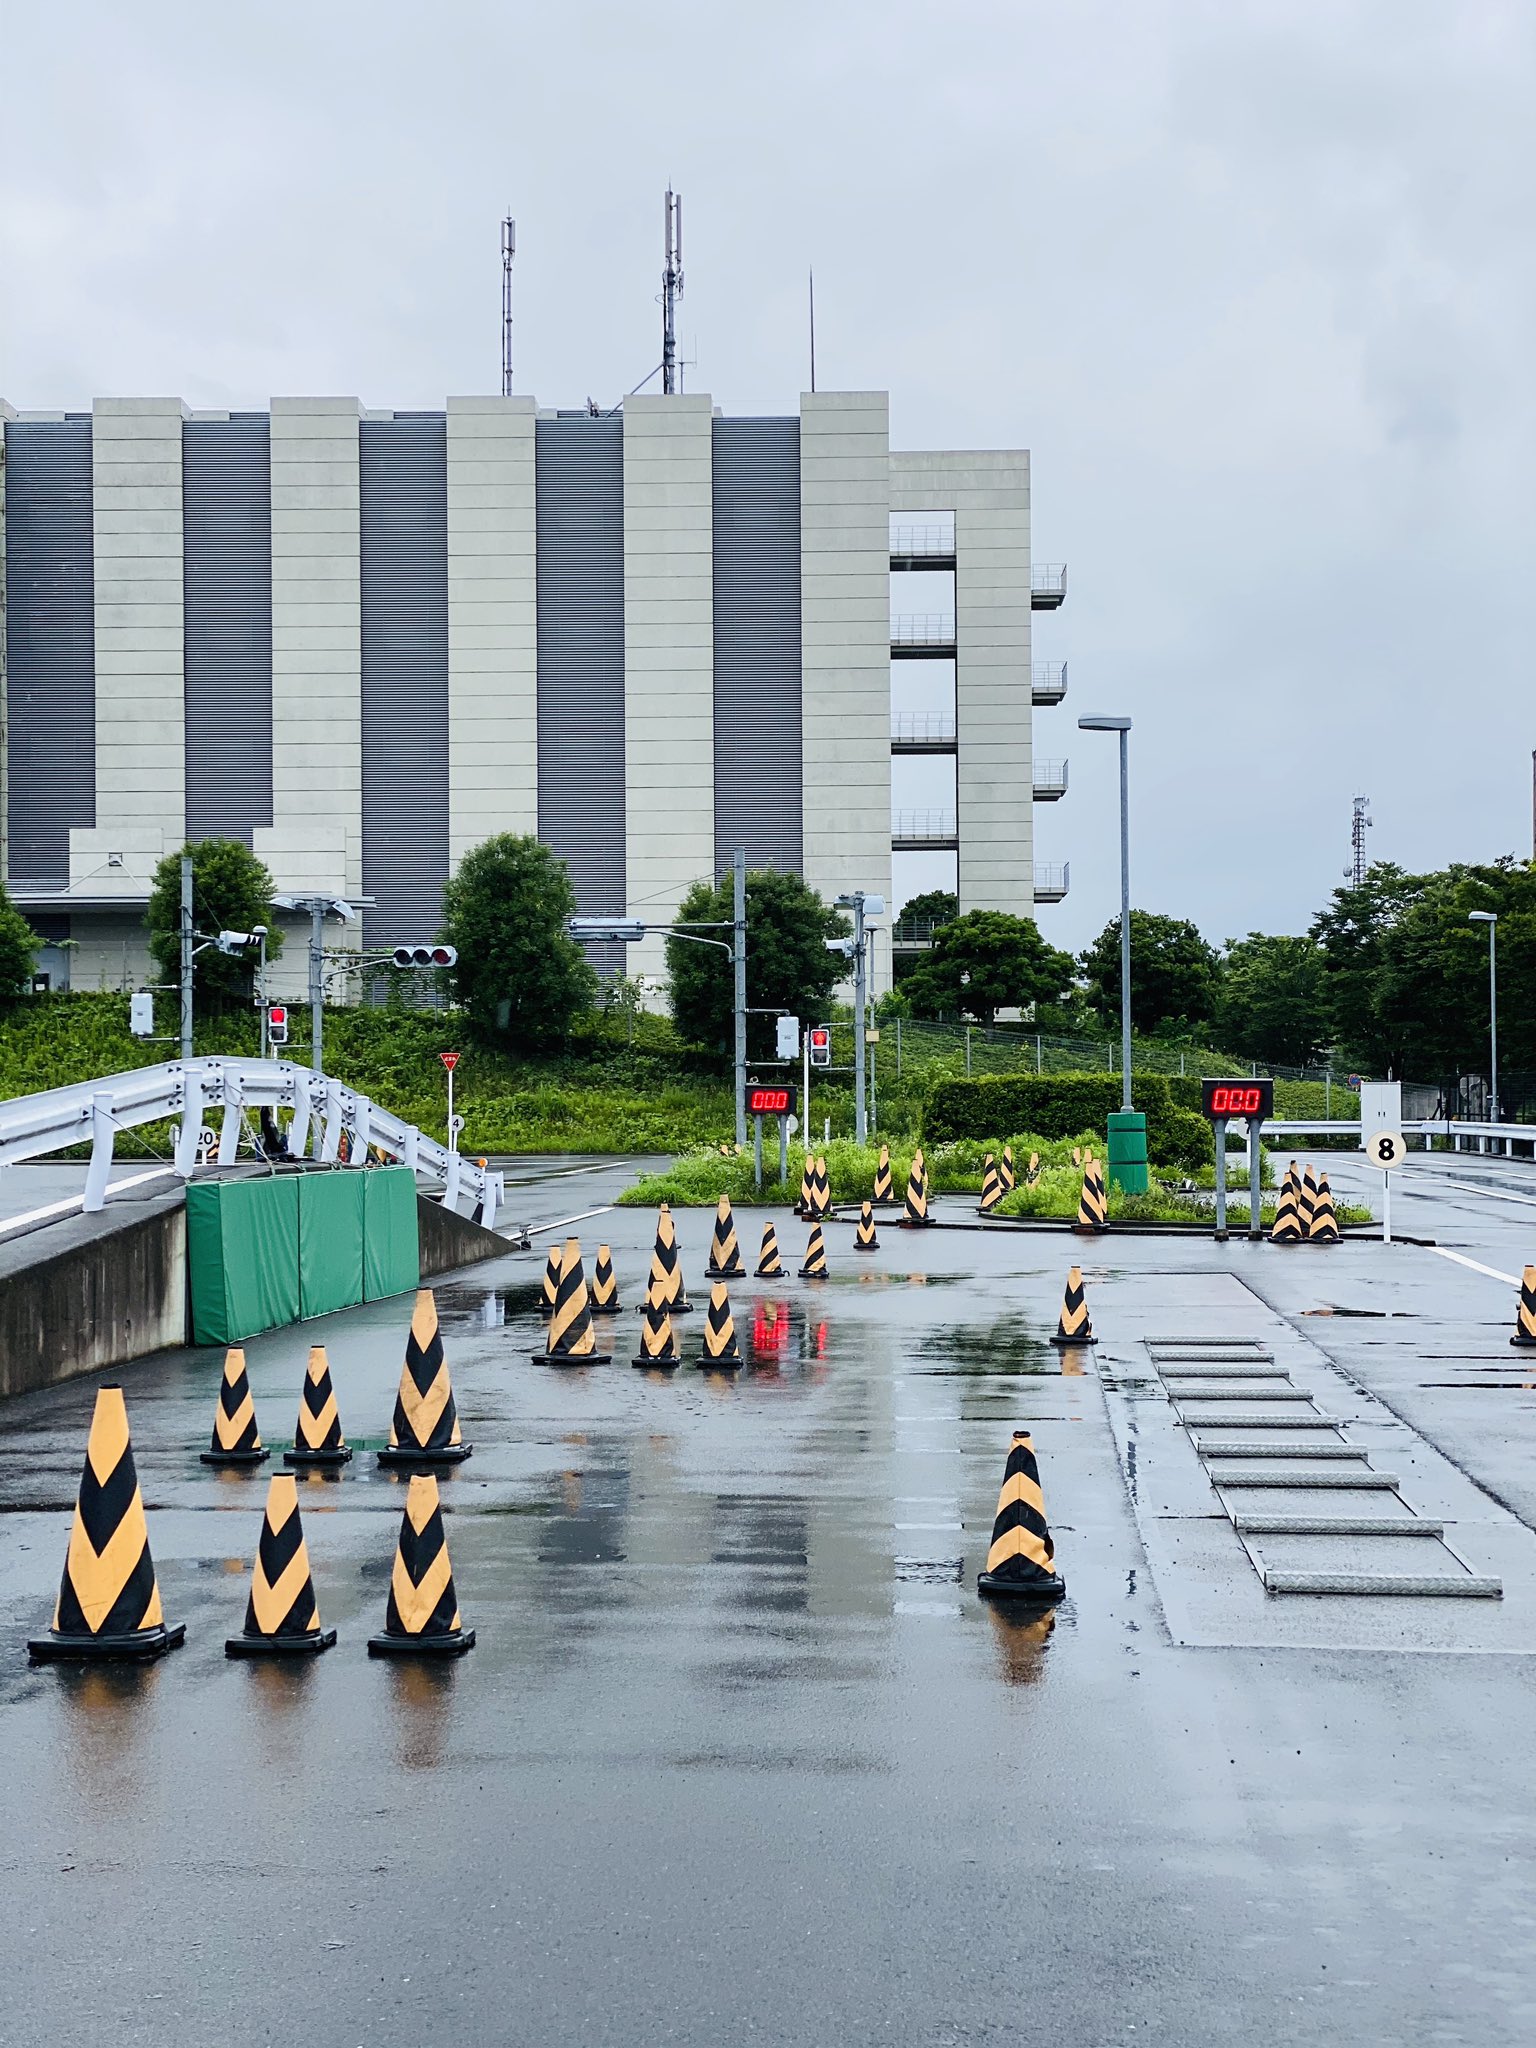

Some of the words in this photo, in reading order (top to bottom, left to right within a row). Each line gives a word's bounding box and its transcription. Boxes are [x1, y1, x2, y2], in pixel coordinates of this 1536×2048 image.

[1214, 1090, 1259, 1110] 00.0
[453, 1118, 459, 1127] 4
[1378, 1138, 1395, 1161] 8
